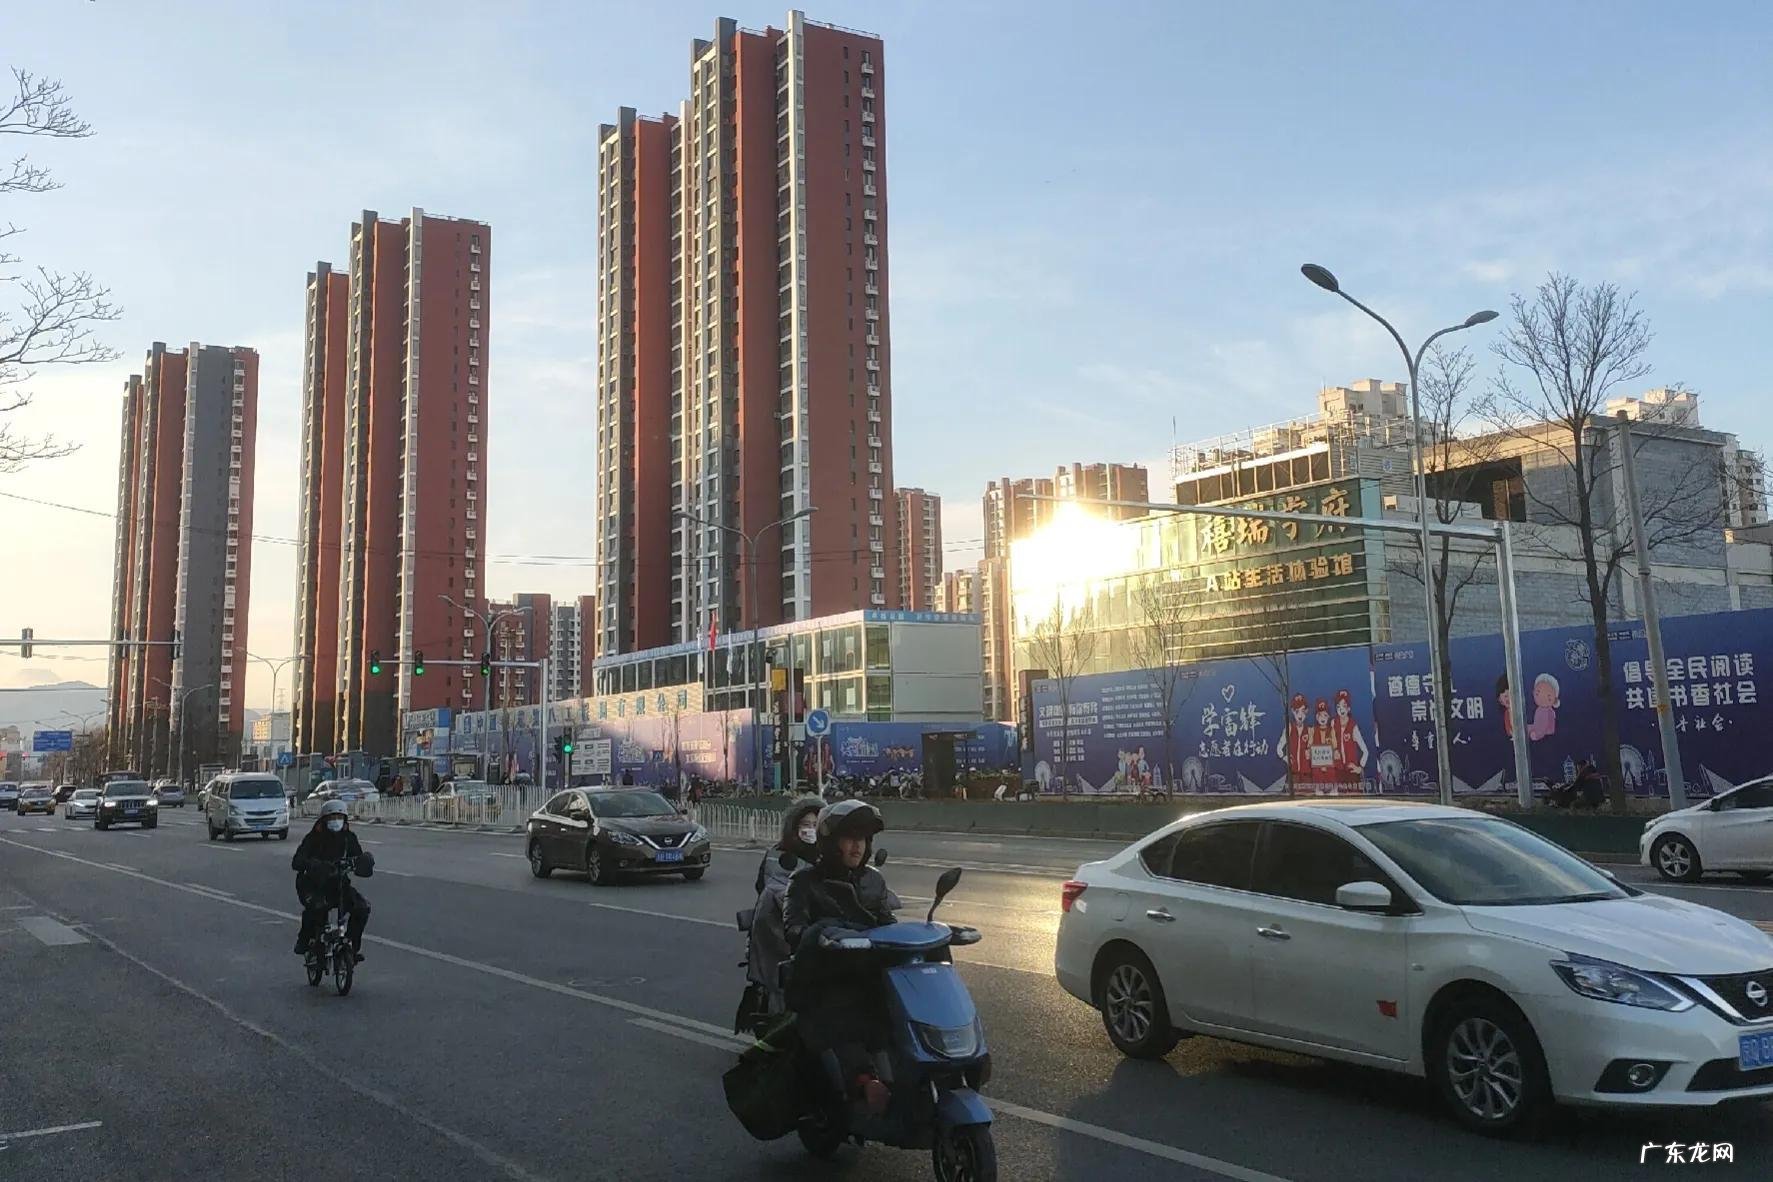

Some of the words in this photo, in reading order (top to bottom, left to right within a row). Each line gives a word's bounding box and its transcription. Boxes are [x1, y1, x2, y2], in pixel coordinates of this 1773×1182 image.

[1199, 739, 1268, 758] 志愿者在行动
